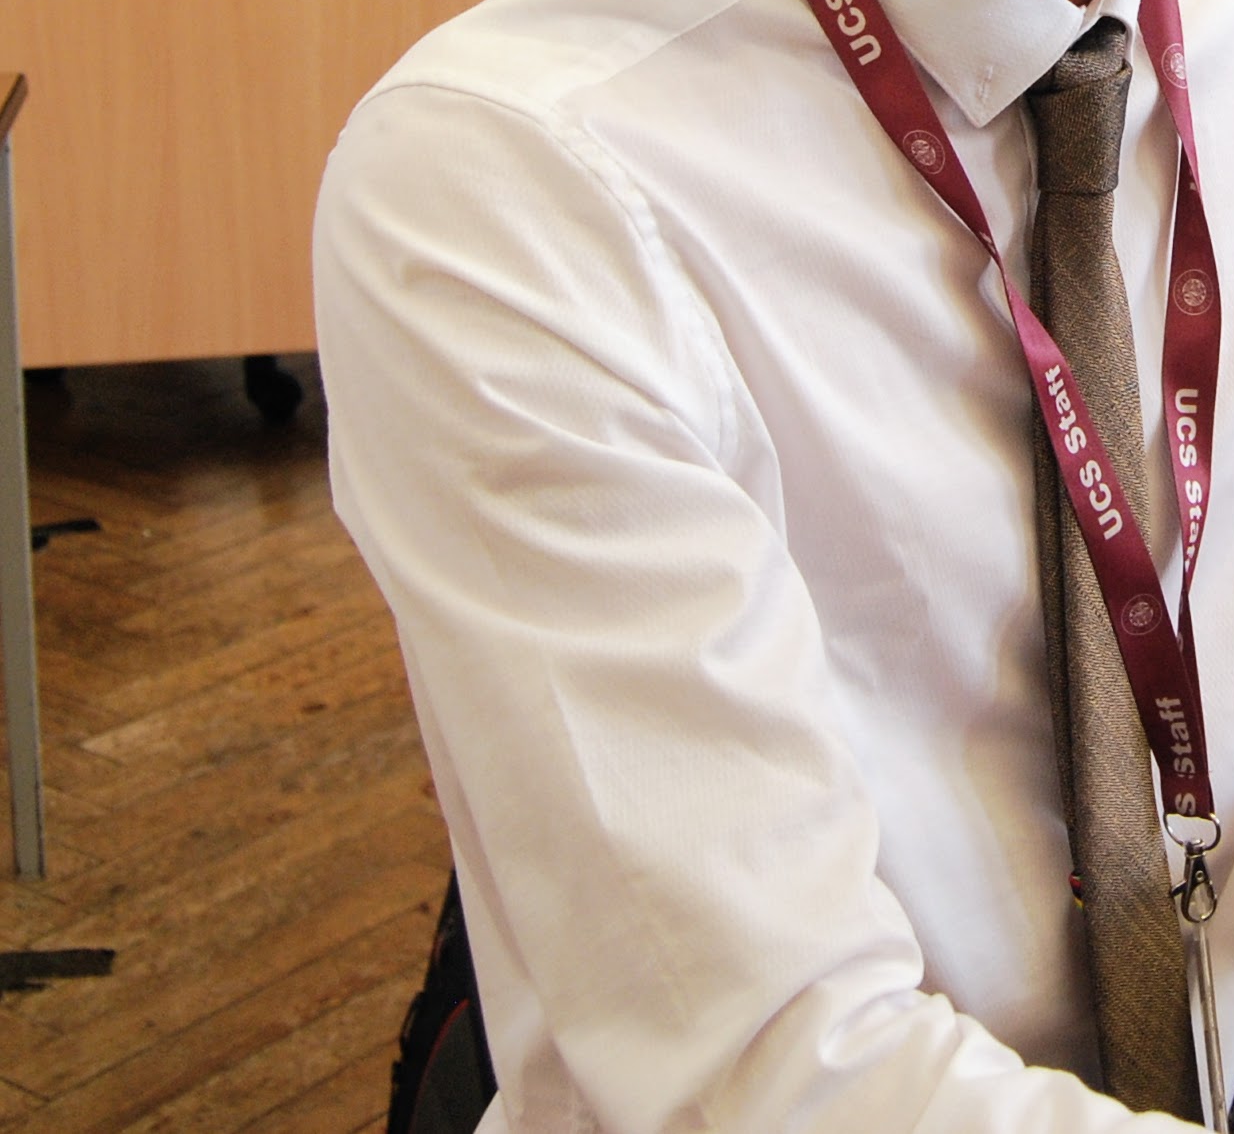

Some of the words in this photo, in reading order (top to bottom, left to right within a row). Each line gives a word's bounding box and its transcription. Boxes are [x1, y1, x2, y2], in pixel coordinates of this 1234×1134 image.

[1045, 365, 1087, 454] Staff
[1175, 388, 1199, 468] UCS
[1079, 460, 1123, 541] UCS
[1155, 696, 1196, 780] Staff
